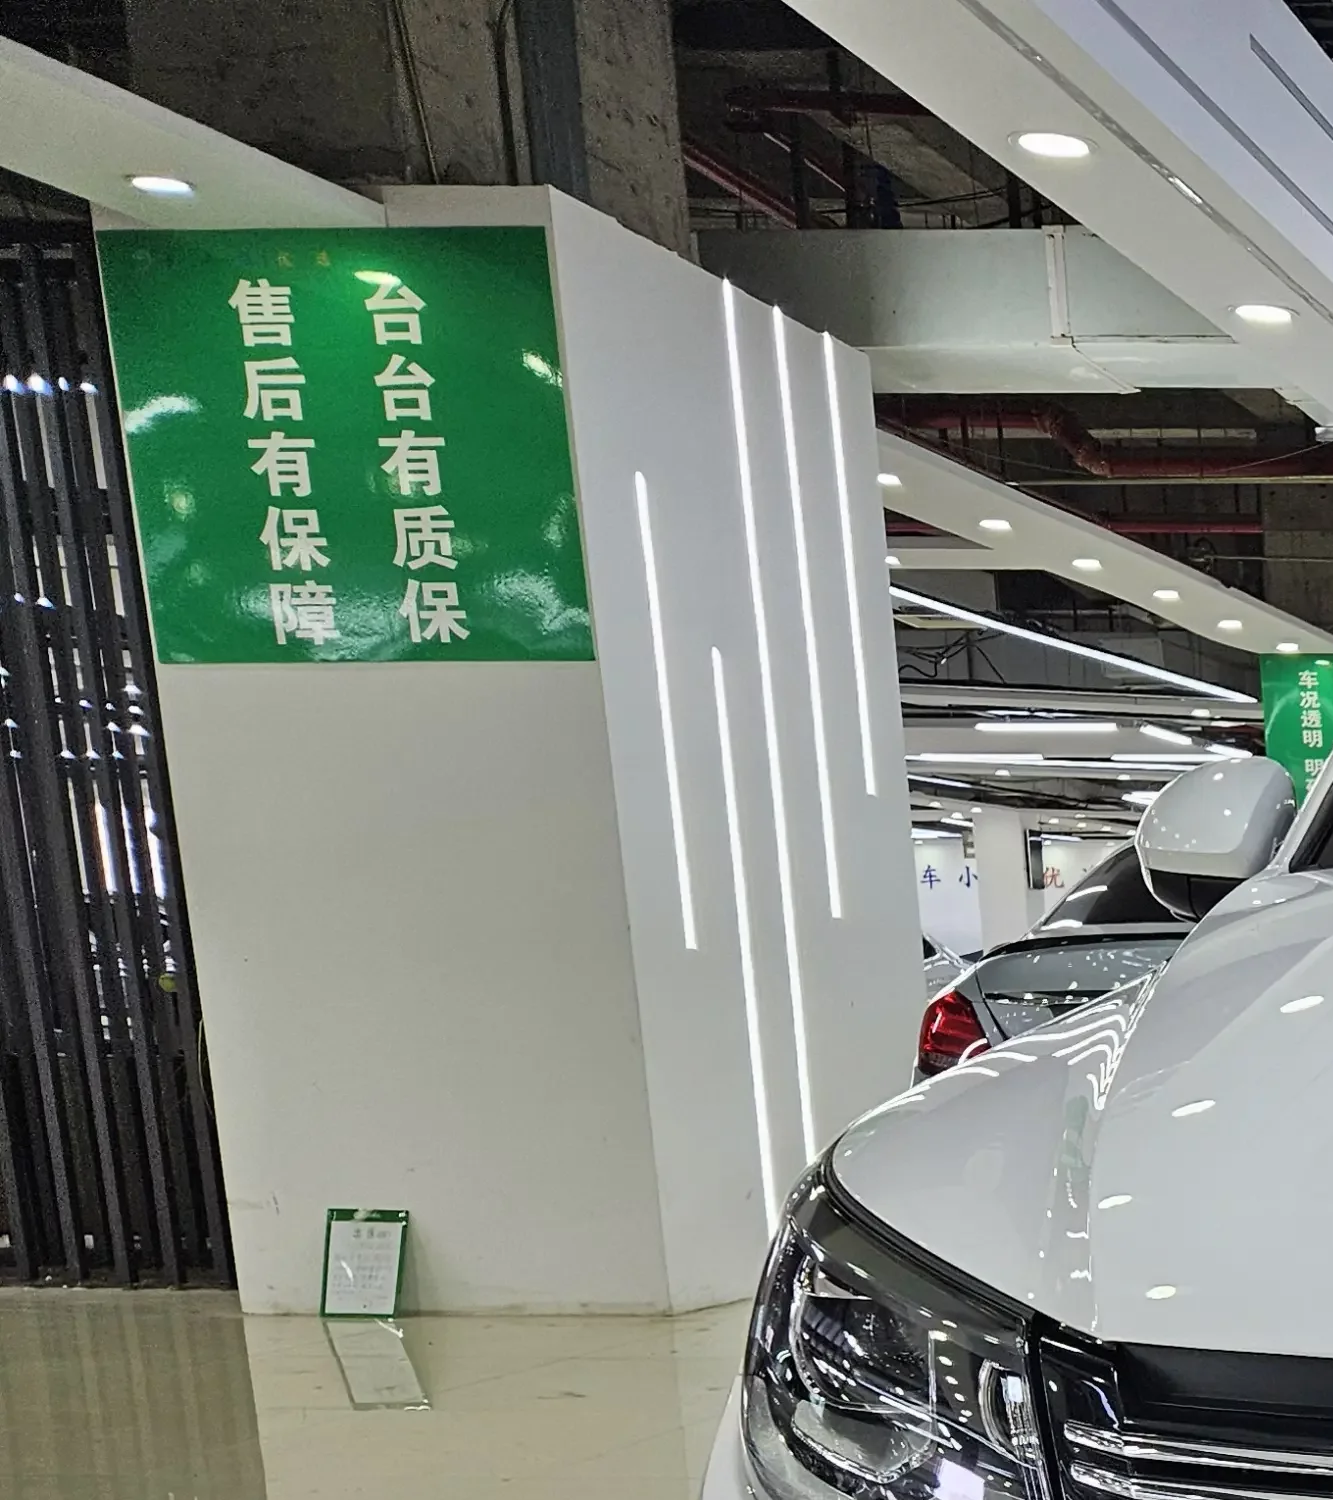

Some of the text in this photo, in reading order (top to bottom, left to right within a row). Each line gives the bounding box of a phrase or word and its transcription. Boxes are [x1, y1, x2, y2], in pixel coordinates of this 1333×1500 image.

[229, 278, 341, 645] 售后有保障
[363, 276, 470, 644] 台台有质保
[1298, 669, 1324, 748] 车况透明
